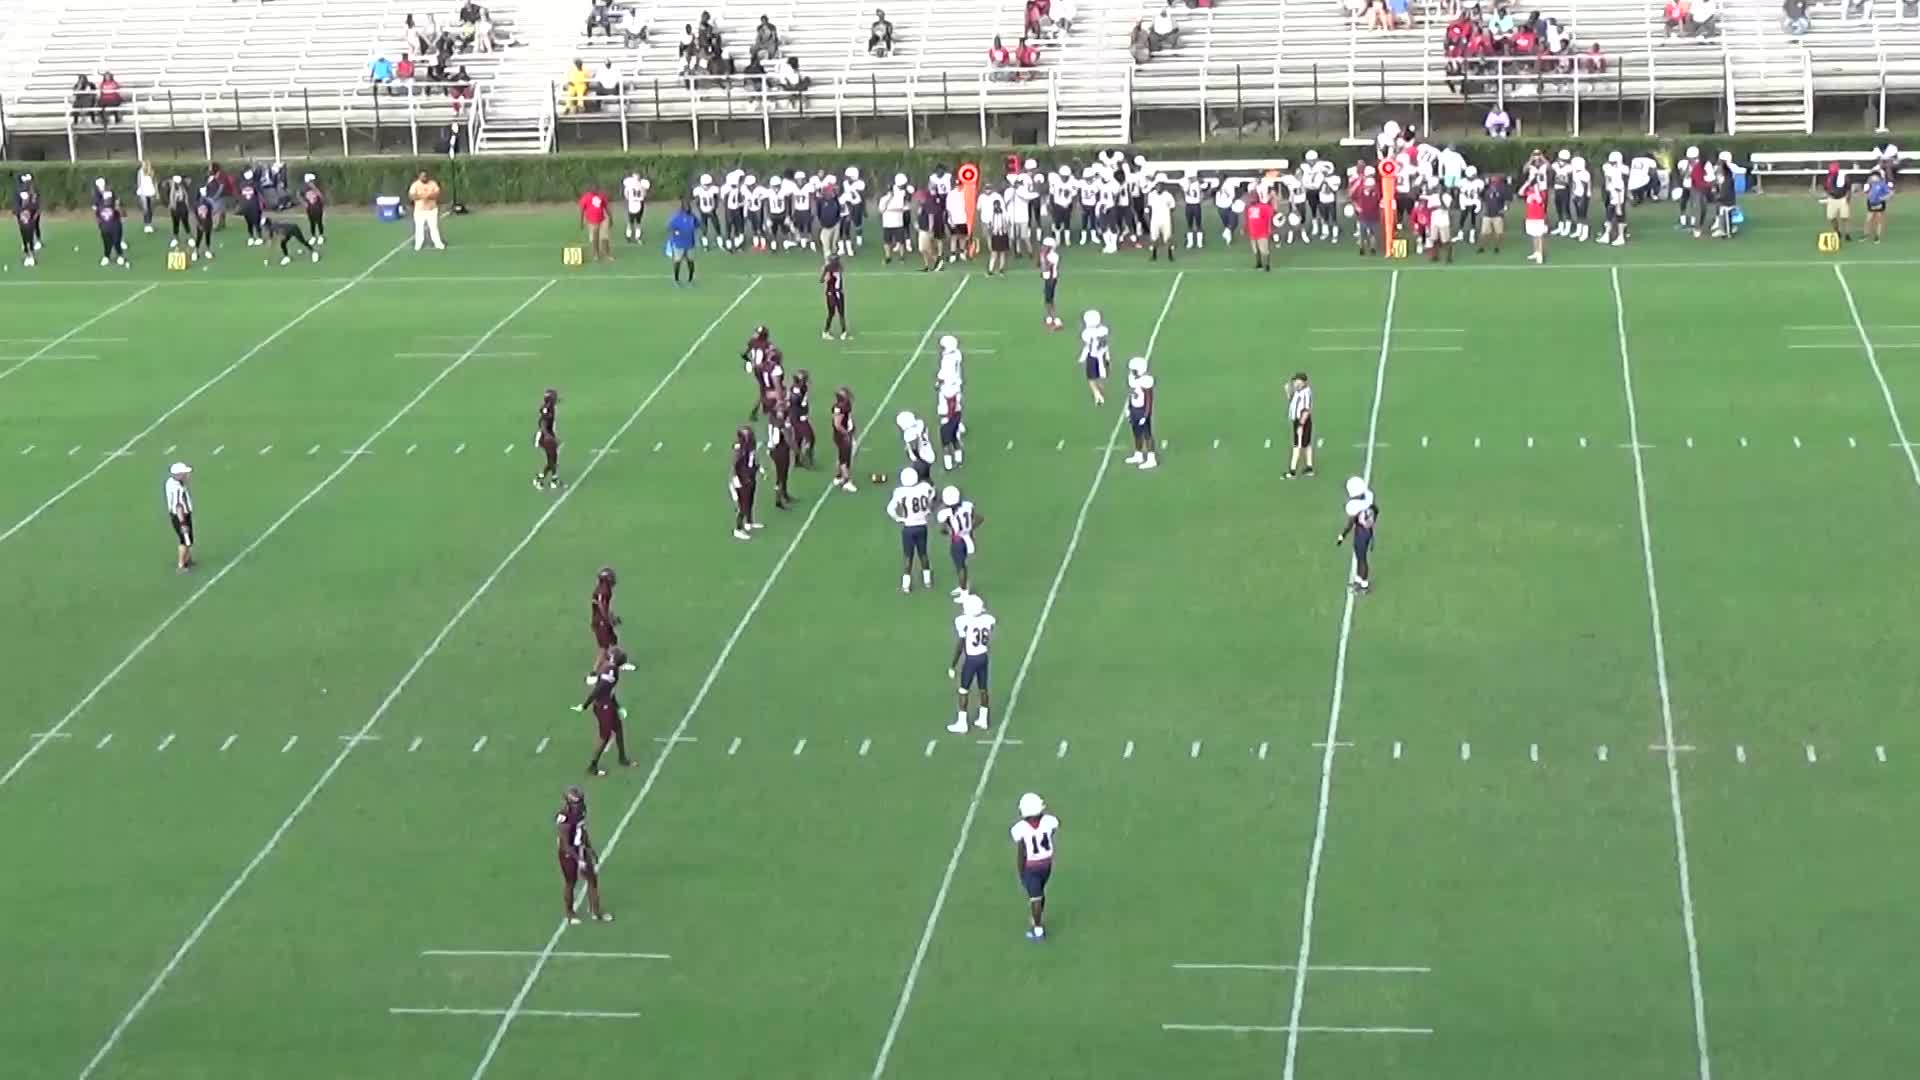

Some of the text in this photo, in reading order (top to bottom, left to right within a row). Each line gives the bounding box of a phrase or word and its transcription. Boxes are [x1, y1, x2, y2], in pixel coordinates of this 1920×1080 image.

[911, 496, 928, 514] 80
[971, 627, 989, 647] 36
[1032, 831, 1051, 855] 14
